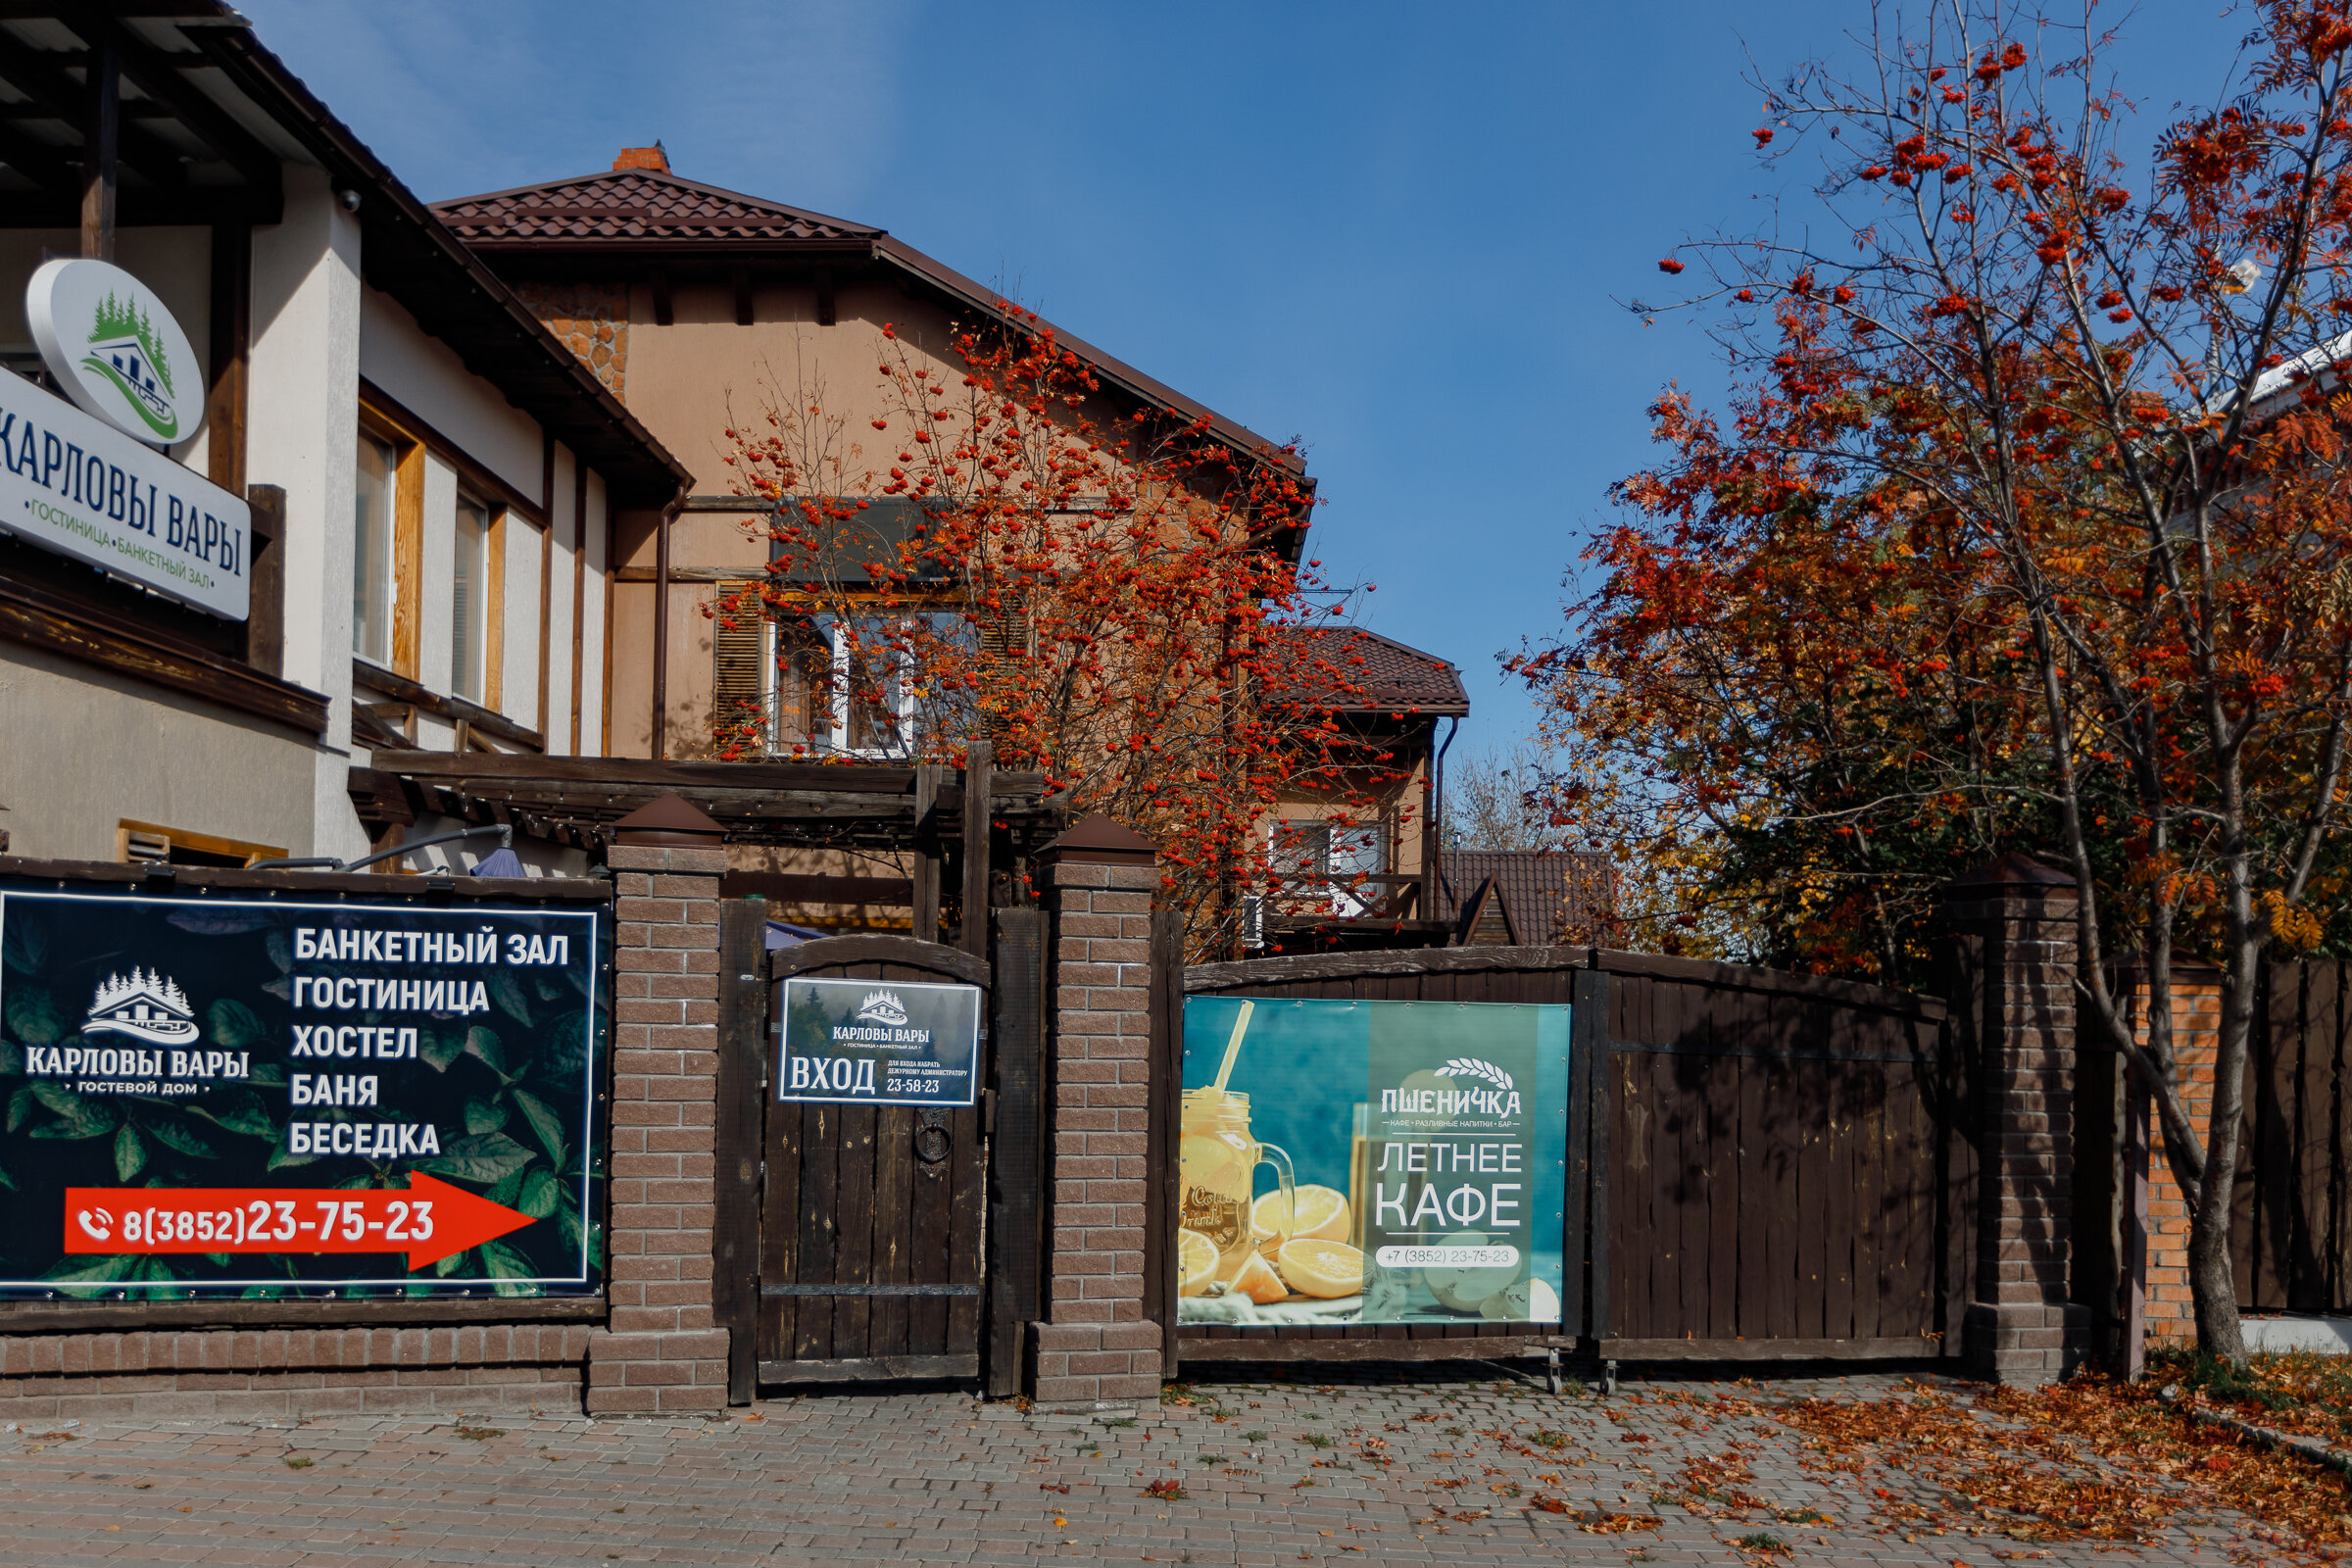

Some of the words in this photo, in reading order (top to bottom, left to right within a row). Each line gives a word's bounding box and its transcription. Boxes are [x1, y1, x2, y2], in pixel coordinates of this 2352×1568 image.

[30, 498, 111, 549] ГОСТИНИЦА
[118, 536, 186, 582] БАНКЕТНЫЙ
[188, 567, 210, 590] ЗАЛ
[167, 493, 242, 577] ВАРЫ
[295, 925, 498, 964] БАНКЕТНЫЙ
[506, 933, 568, 965] ЗАЛ
[294, 976, 490, 1016] ГОСТИНИЦА
[292, 1025, 417, 1058] ХОСТЕЛ
[832, 1026, 892, 1042] КАРЛОВЫ
[895, 1028, 929, 1043] ВАРЫ
[25, 1046, 164, 1077] КАРЛОВЫ
[171, 1050, 250, 1078] ВАРЫ
[790, 1056, 876, 1096] ВХОД
[921, 1068, 968, 1077] АДМИНИСТРАТОРУ
[77, 1080, 157, 1094] ГОСТЕВОЙ
[162, 1083, 198, 1095] ДОМ
[291, 1074, 378, 1105] БАНЯ
[887, 1078, 940, 1094] 23-58-23
[1381, 1086, 1522, 1119] ПШЕНИЧКА
[290, 1122, 441, 1159] БЕСЕДКА
[1377, 1142, 1523, 1173] ЛЕТНЕЕ
[1375, 1182, 1522, 1227] КАФЕ
[123, 1200, 435, 1246] 8(3852)23-75-23
[1385, 1250, 1400, 1262] +7
[1404, 1250, 1446, 1263] (3852)
[1450, 1250, 1509, 1262] 23-75-23
